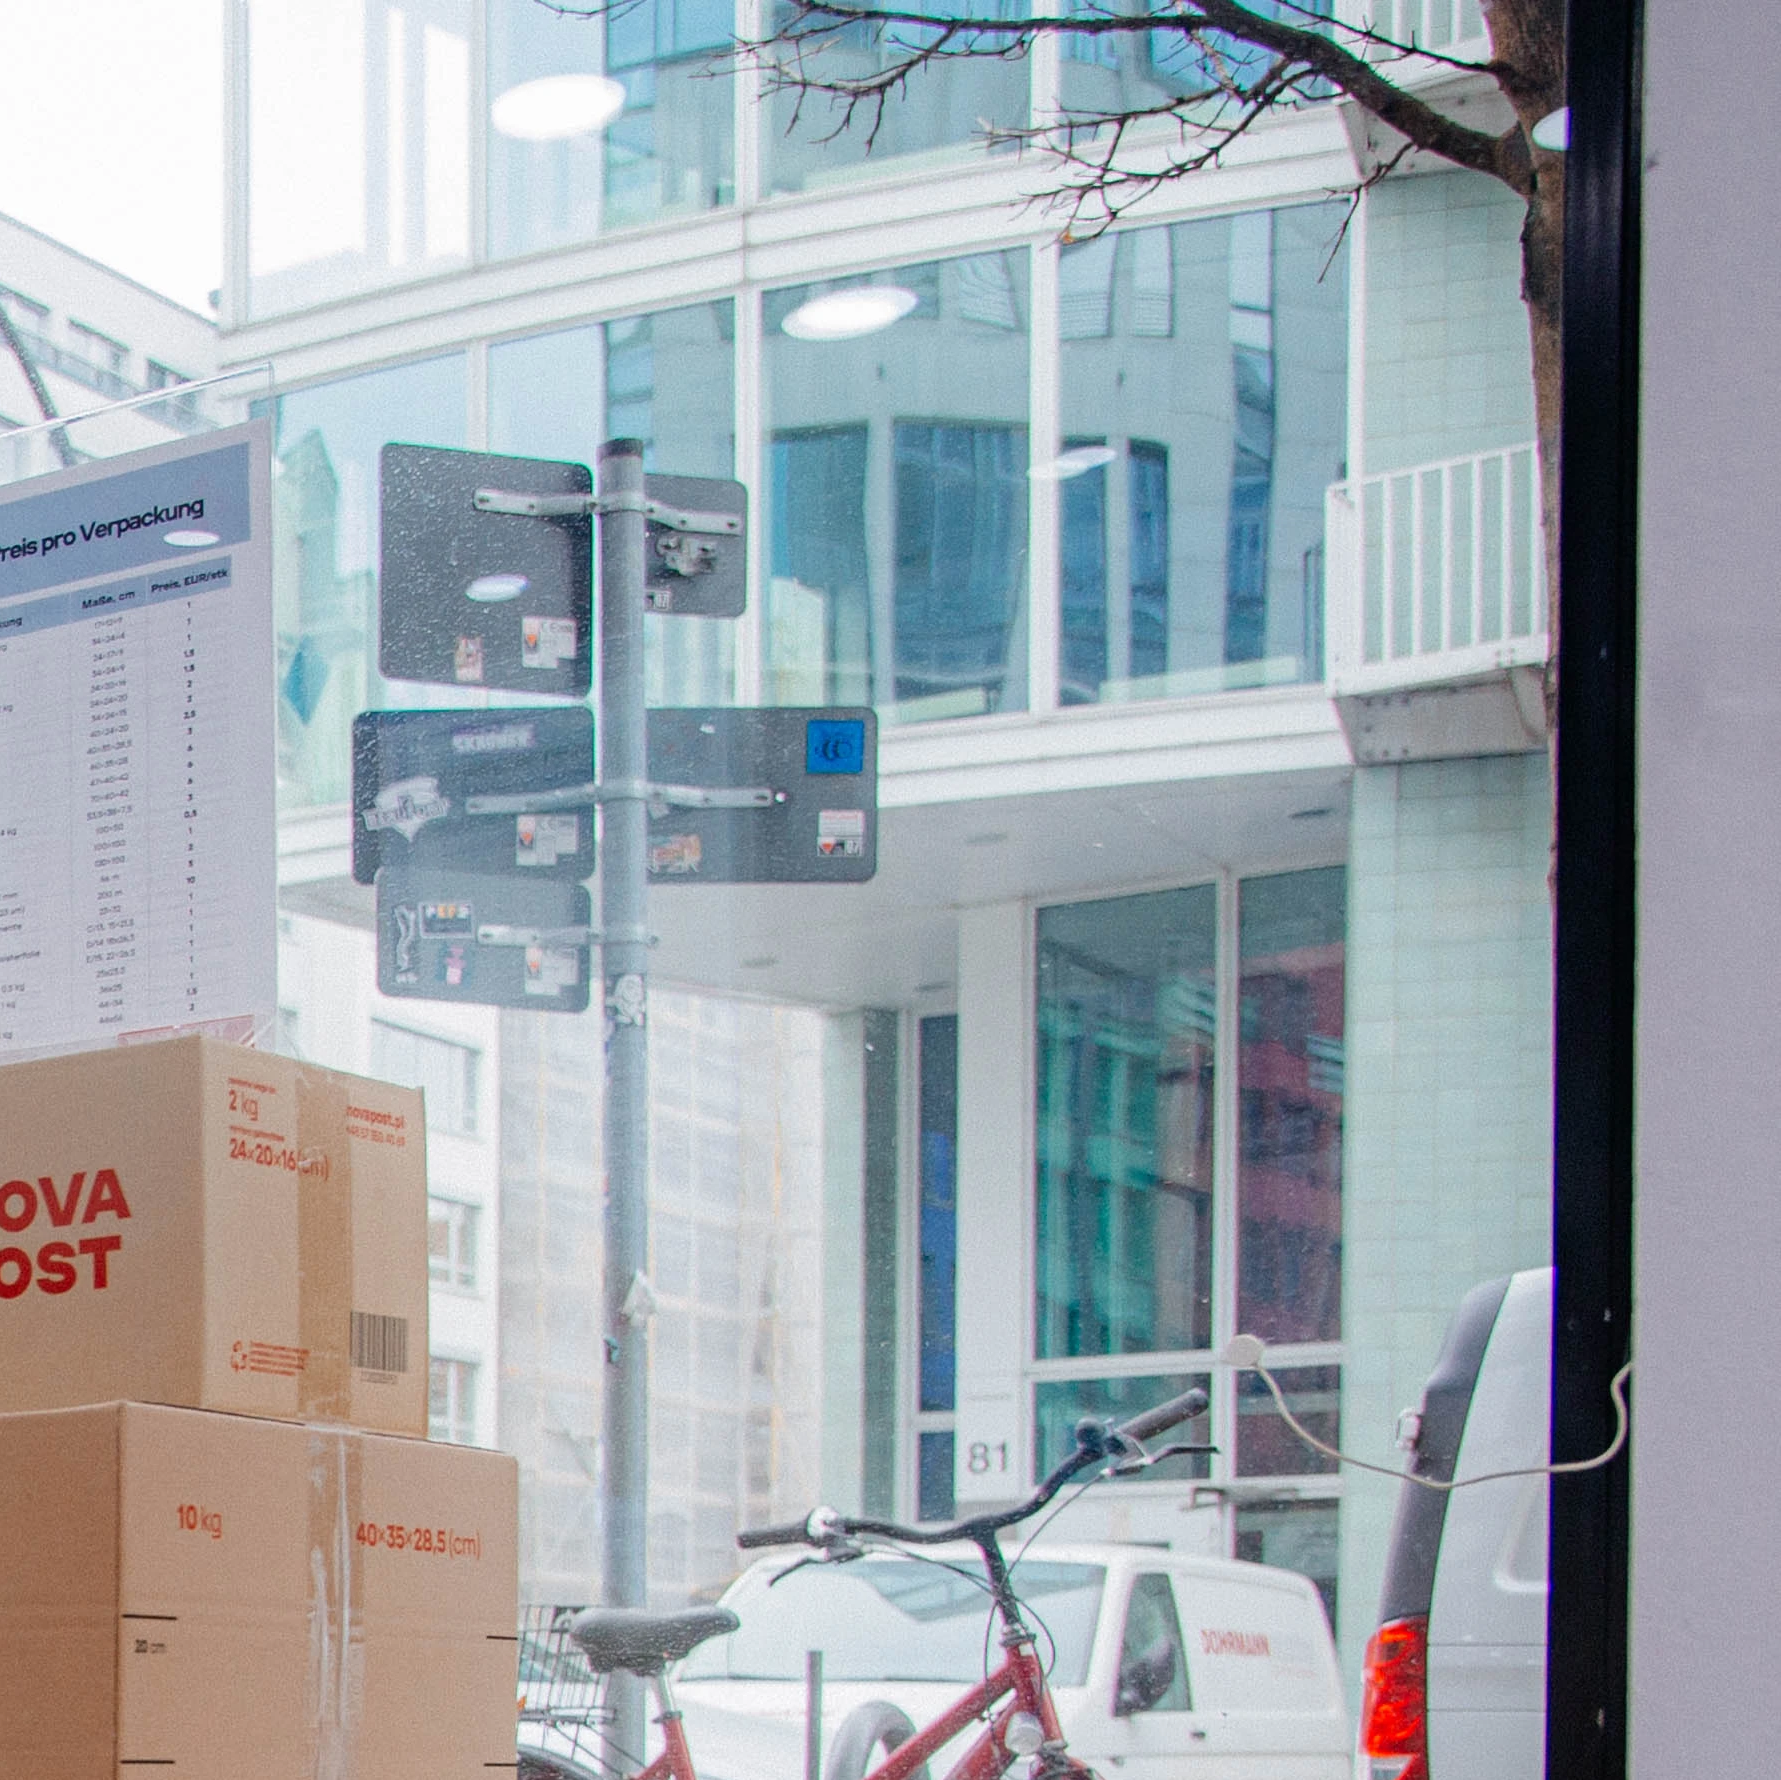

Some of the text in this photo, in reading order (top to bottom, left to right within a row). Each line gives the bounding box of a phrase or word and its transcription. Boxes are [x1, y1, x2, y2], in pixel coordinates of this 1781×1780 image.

[41, 530, 76, 556] pro
[80, 498, 205, 541] Verpackung
[119, 591, 135, 601] cm
[229, 1089, 259, 1121] 2 kg
[968, 1442, 1008, 1474] 81
